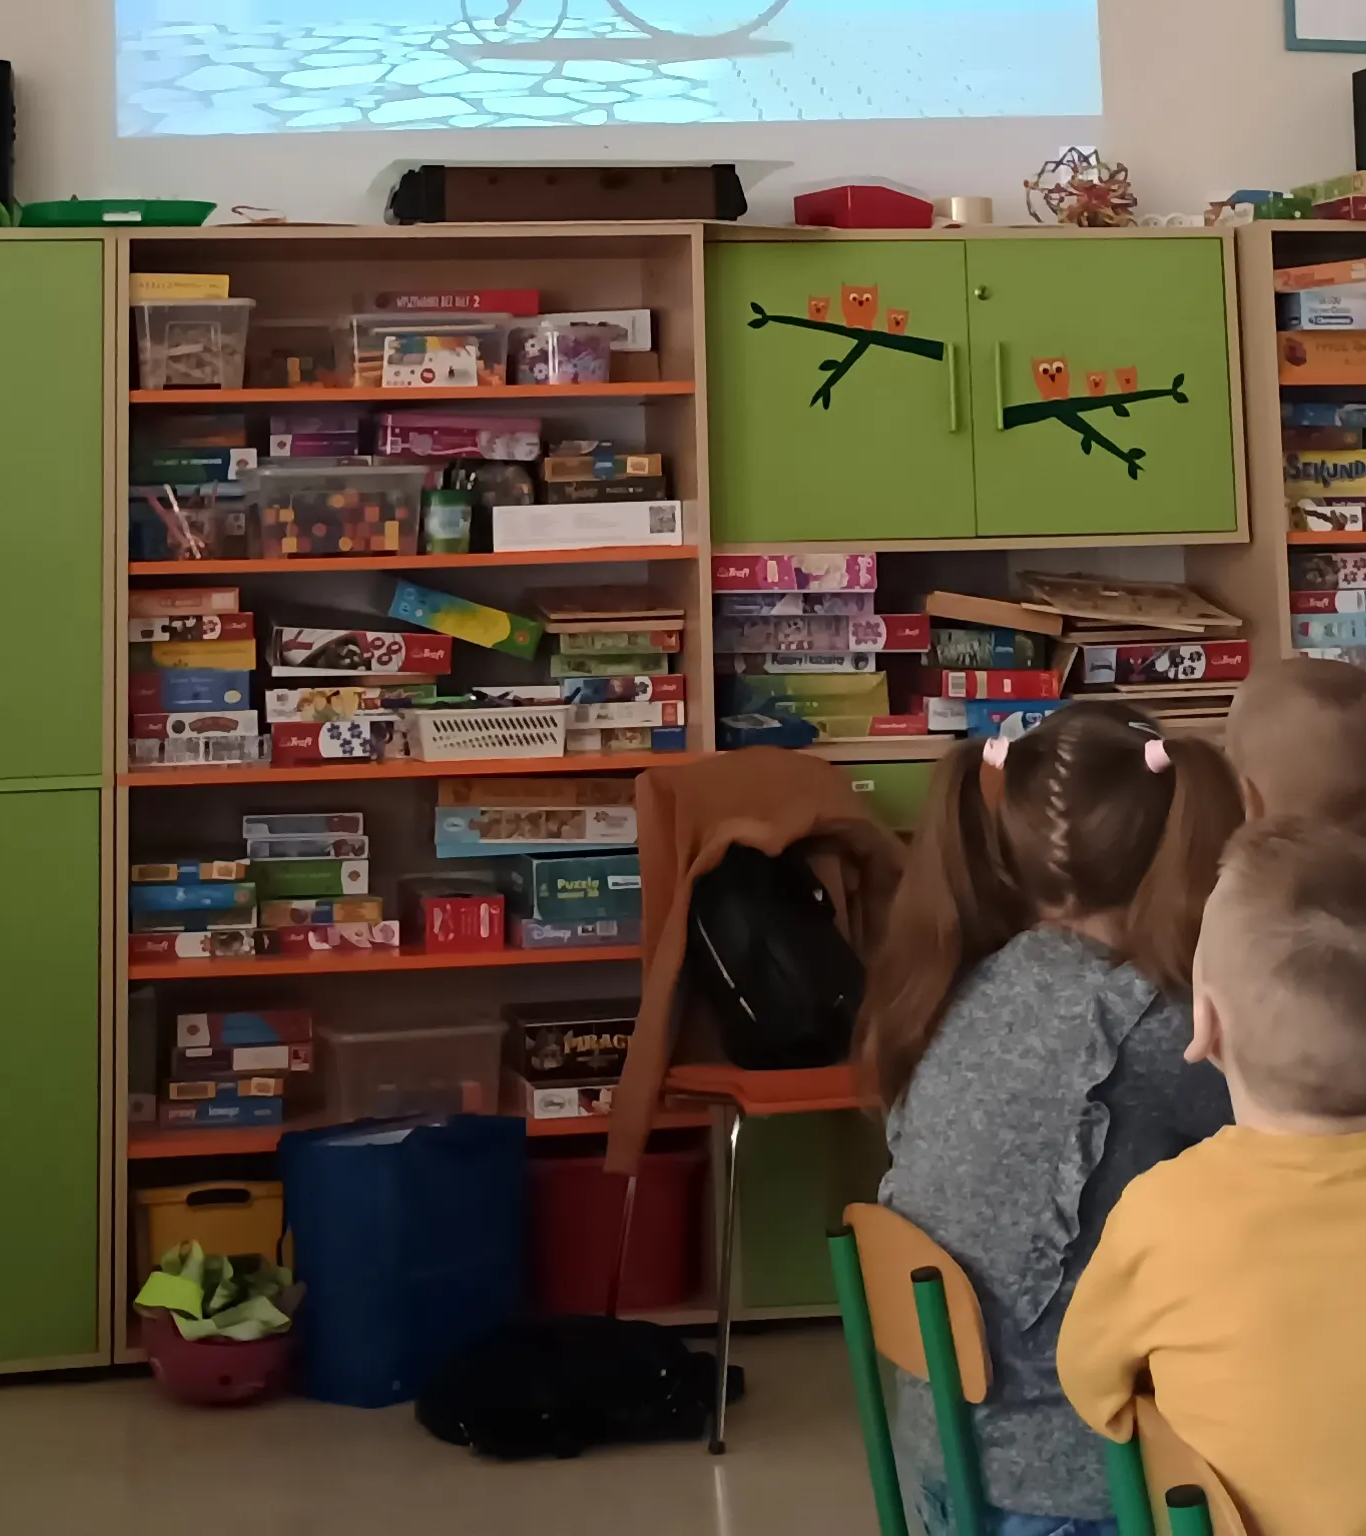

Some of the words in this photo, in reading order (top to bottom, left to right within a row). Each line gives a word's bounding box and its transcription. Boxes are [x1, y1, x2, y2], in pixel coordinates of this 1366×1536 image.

[473, 295, 481, 307] 2
[729, 567, 750, 578] Trefl
[1310, 597, 1329, 609] Trefl
[423, 647, 446, 660] Trefl
[1221, 654, 1243, 665] Trefl
[291, 735, 313, 748] Trefl
[557, 876, 600, 891] Puzzle
[530, 924, 572, 942] Disney
